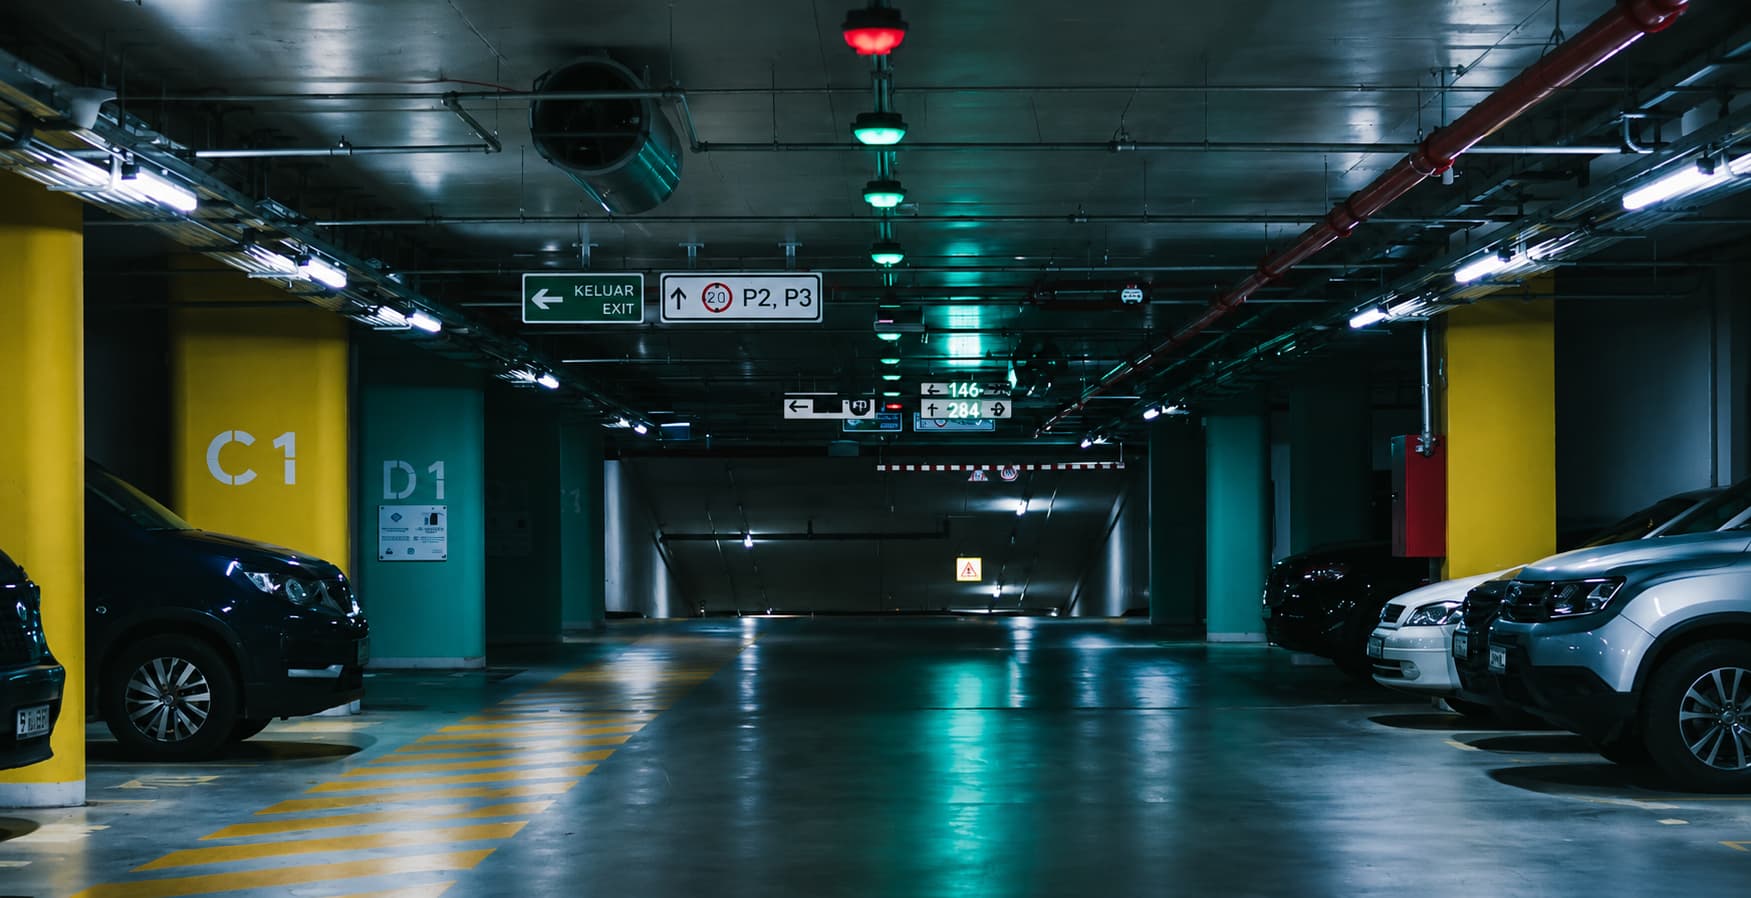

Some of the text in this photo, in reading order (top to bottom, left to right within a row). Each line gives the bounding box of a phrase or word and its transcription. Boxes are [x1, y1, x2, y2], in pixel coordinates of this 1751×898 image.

[574, 284, 634, 297] KELUAR
[707, 288, 812, 310] 20 P2, P3
[602, 303, 635, 315] EXIT
[947, 402, 980, 419] 284
